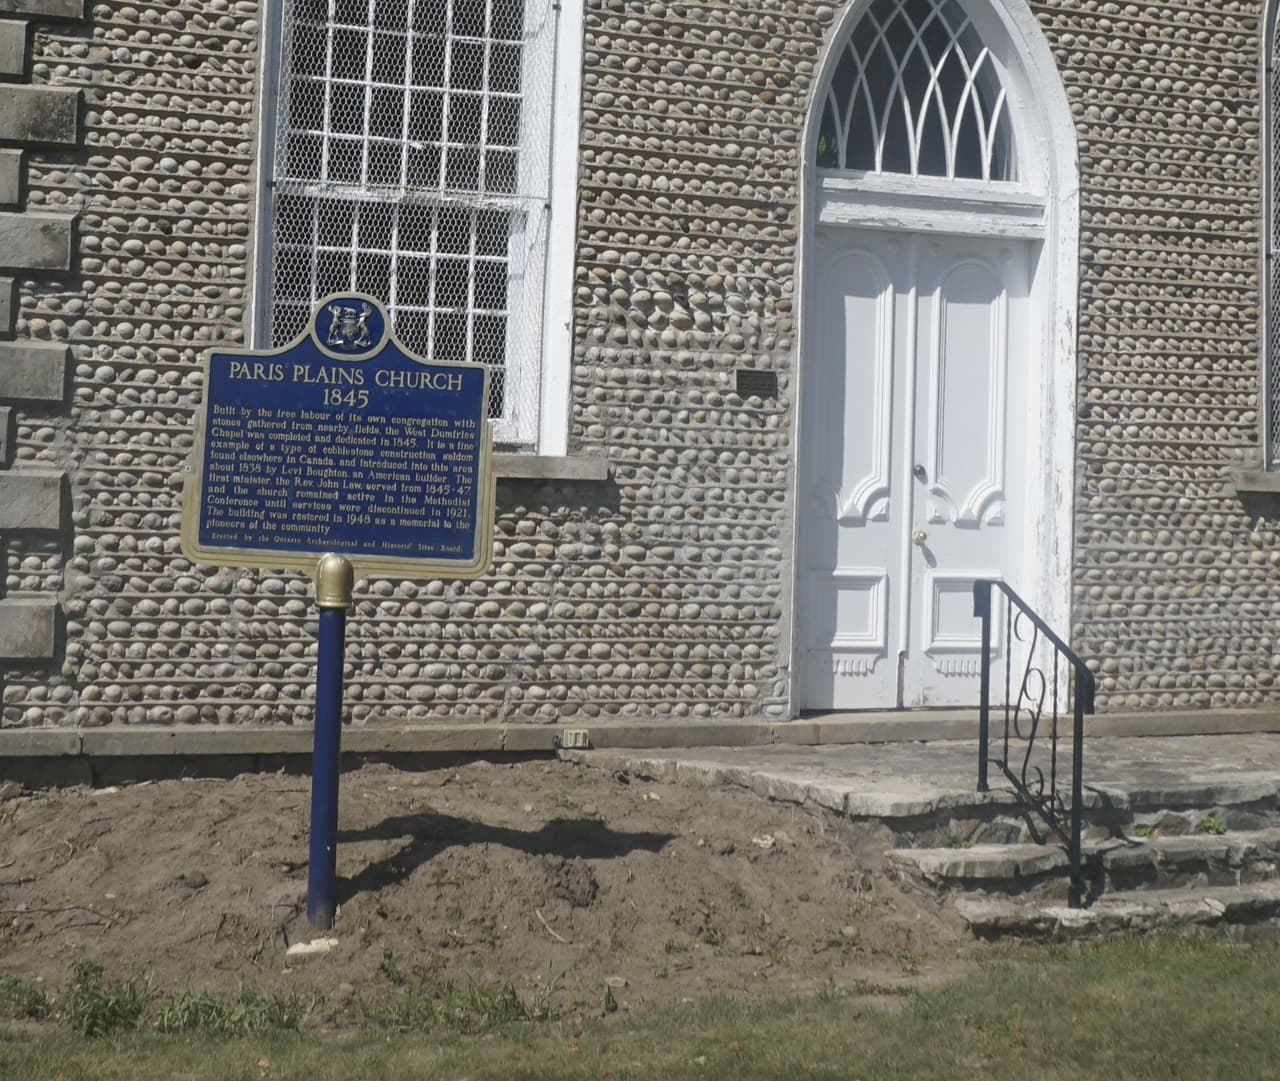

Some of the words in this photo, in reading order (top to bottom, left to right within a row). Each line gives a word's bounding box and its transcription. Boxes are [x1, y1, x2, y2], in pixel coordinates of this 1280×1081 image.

[229, 361, 284, 381] PARIS
[292, 364, 364, 386] PLAINS
[375, 370, 463, 391] CHURCH
[323, 388, 369, 408] 1845
[213, 404, 236, 415] Built
[241, 406, 252, 418] by
[258, 407, 272, 417] the
[277, 408, 296, 418] free
[301, 409, 331, 420] labour
[336, 411, 344, 421] of
[349, 412, 362, 422] its
[368, 415, 386, 423] own
[391, 417, 448, 428] congregation
[454, 418, 476, 429] with
[211, 427, 243, 439] Chapel
[247, 431, 265, 439] was
[268, 431, 311, 443] completed
[315, 433, 331, 444] and
[335, 434, 376, 445] dedicated
[381, 436, 389, 446] in
[427, 439, 434, 449] It
[437, 440, 446, 449] is
[457, 441, 474, 451] fine
[213, 418, 241, 427] stones
[247, 419, 286, 430] gathered
[291, 421, 313, 431] from
[318, 422, 349, 434] nearby
[385, 425, 399, 435] the
[405, 427, 426, 437] West
[431, 429, 475, 439] Dumfries
[210, 439, 250, 451] example
[255, 441, 265, 451] of
[281, 443, 303, 454] type
[307, 444, 316, 454] of
[322, 445, 374, 457] cobblestone
[380, 447, 436, 460] construction
[442, 451, 473, 461] seldom
[210, 449, 236, 460] found
[239, 451, 283, 463] elsewhere
[286, 453, 296, 464] in
[339, 457, 356, 467] and
[360, 458, 408, 470] introduced
[411, 461, 428, 471] into
[431, 462, 449, 472] this
[453, 465, 473, 473] area
[209, 461, 234, 471] about
[239, 463, 261, 473] 1838
[266, 463, 277, 475] by
[281, 464, 302, 475] Levi
[367, 470, 411, 481] American
[455, 474, 473, 484] The
[209, 472, 230, 482] first
[276, 475, 290, 486] the
[318, 478, 339, 489] John
[366, 482, 397, 492] served
[401, 483, 422, 493] from
[207, 483, 225, 493] and
[233, 485, 249, 495] the
[256, 486, 288, 497] church
[296, 489, 339, 500] remained
[347, 491, 375, 502] active
[384, 493, 394, 503] in
[401, 493, 417, 504] the
[424, 495, 471, 506] Methodist
[207, 494, 259, 506] Conference
[265, 498, 287, 508] until
[292, 500, 332, 510] services
[338, 503, 361, 512] were
[368, 503, 425, 516] discontinued
[431, 506, 441, 517] in
[206, 517, 245, 529] pioneers
[249, 519, 259, 530] of
[262, 521, 277, 531] the
[281, 522, 331, 535] community
[207, 505, 224, 516] The
[228, 506, 265, 520] building
[269, 511, 288, 520] was
[292, 510, 329, 521] restored
[333, 512, 343, 523] in
[346, 513, 371, 525] 1948
[400, 518, 440, 528] memorial
[443, 518, 452, 529] to
[456, 520, 470, 529] the
[244, 533, 252, 542] by
[258, 534, 269, 542] the
[274, 535, 300, 545] Ontario
[363, 540, 376, 548] and
